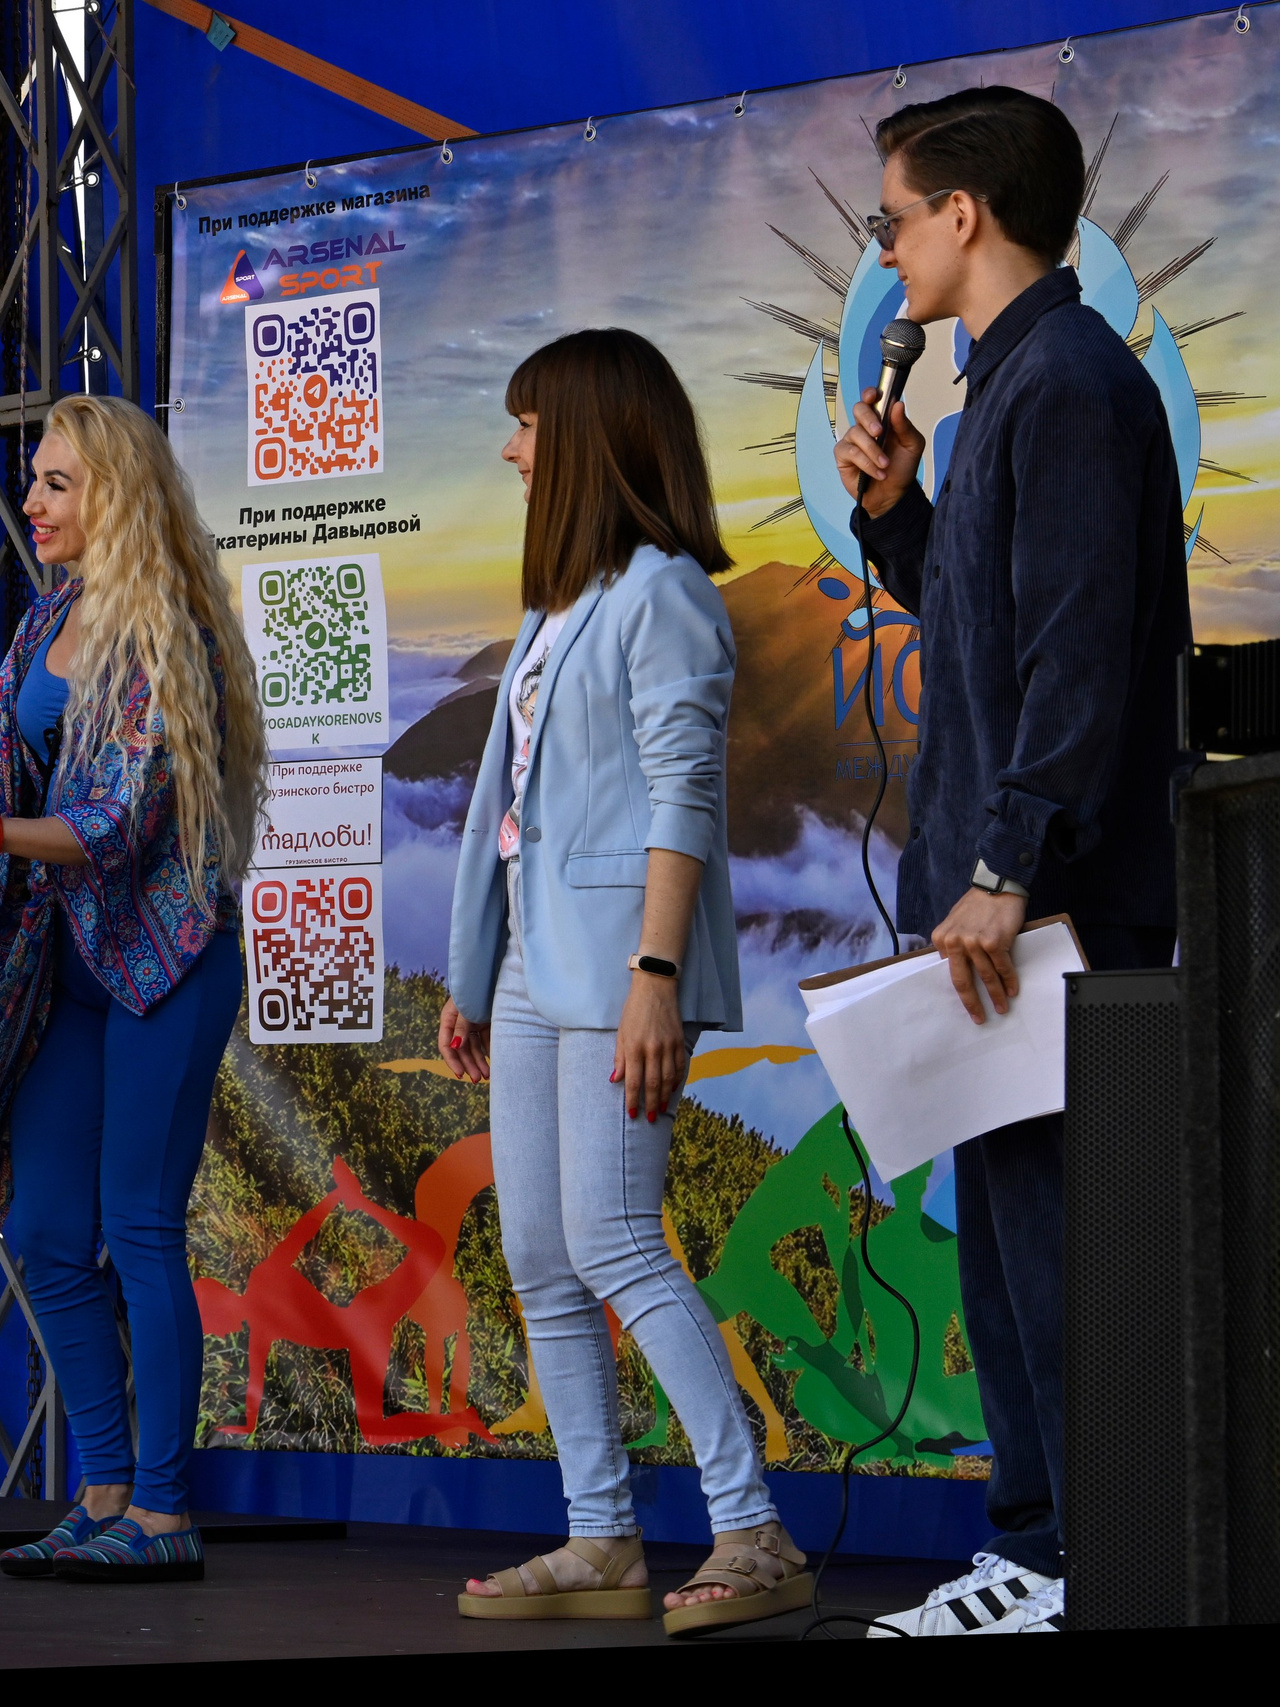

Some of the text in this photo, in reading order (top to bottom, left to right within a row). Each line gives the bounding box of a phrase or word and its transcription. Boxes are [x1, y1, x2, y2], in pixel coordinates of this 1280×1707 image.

[198, 184, 431, 236] При поддержке магазина
[262, 230, 407, 271] ARSENAL
[235, 274, 256, 283] SPORT
[279, 261, 383, 297] SPORT
[221, 293, 248, 302] ARSENAL
[239, 497, 386, 528] При поддержке
[211, 514, 421, 551] катерины Давыдовой
[272, 763, 363, 780] При поддержке
[269, 781, 375, 801] узинского бистро
[285, 857, 348, 866] ГРУЗИНСКОЕ БИСТРО
